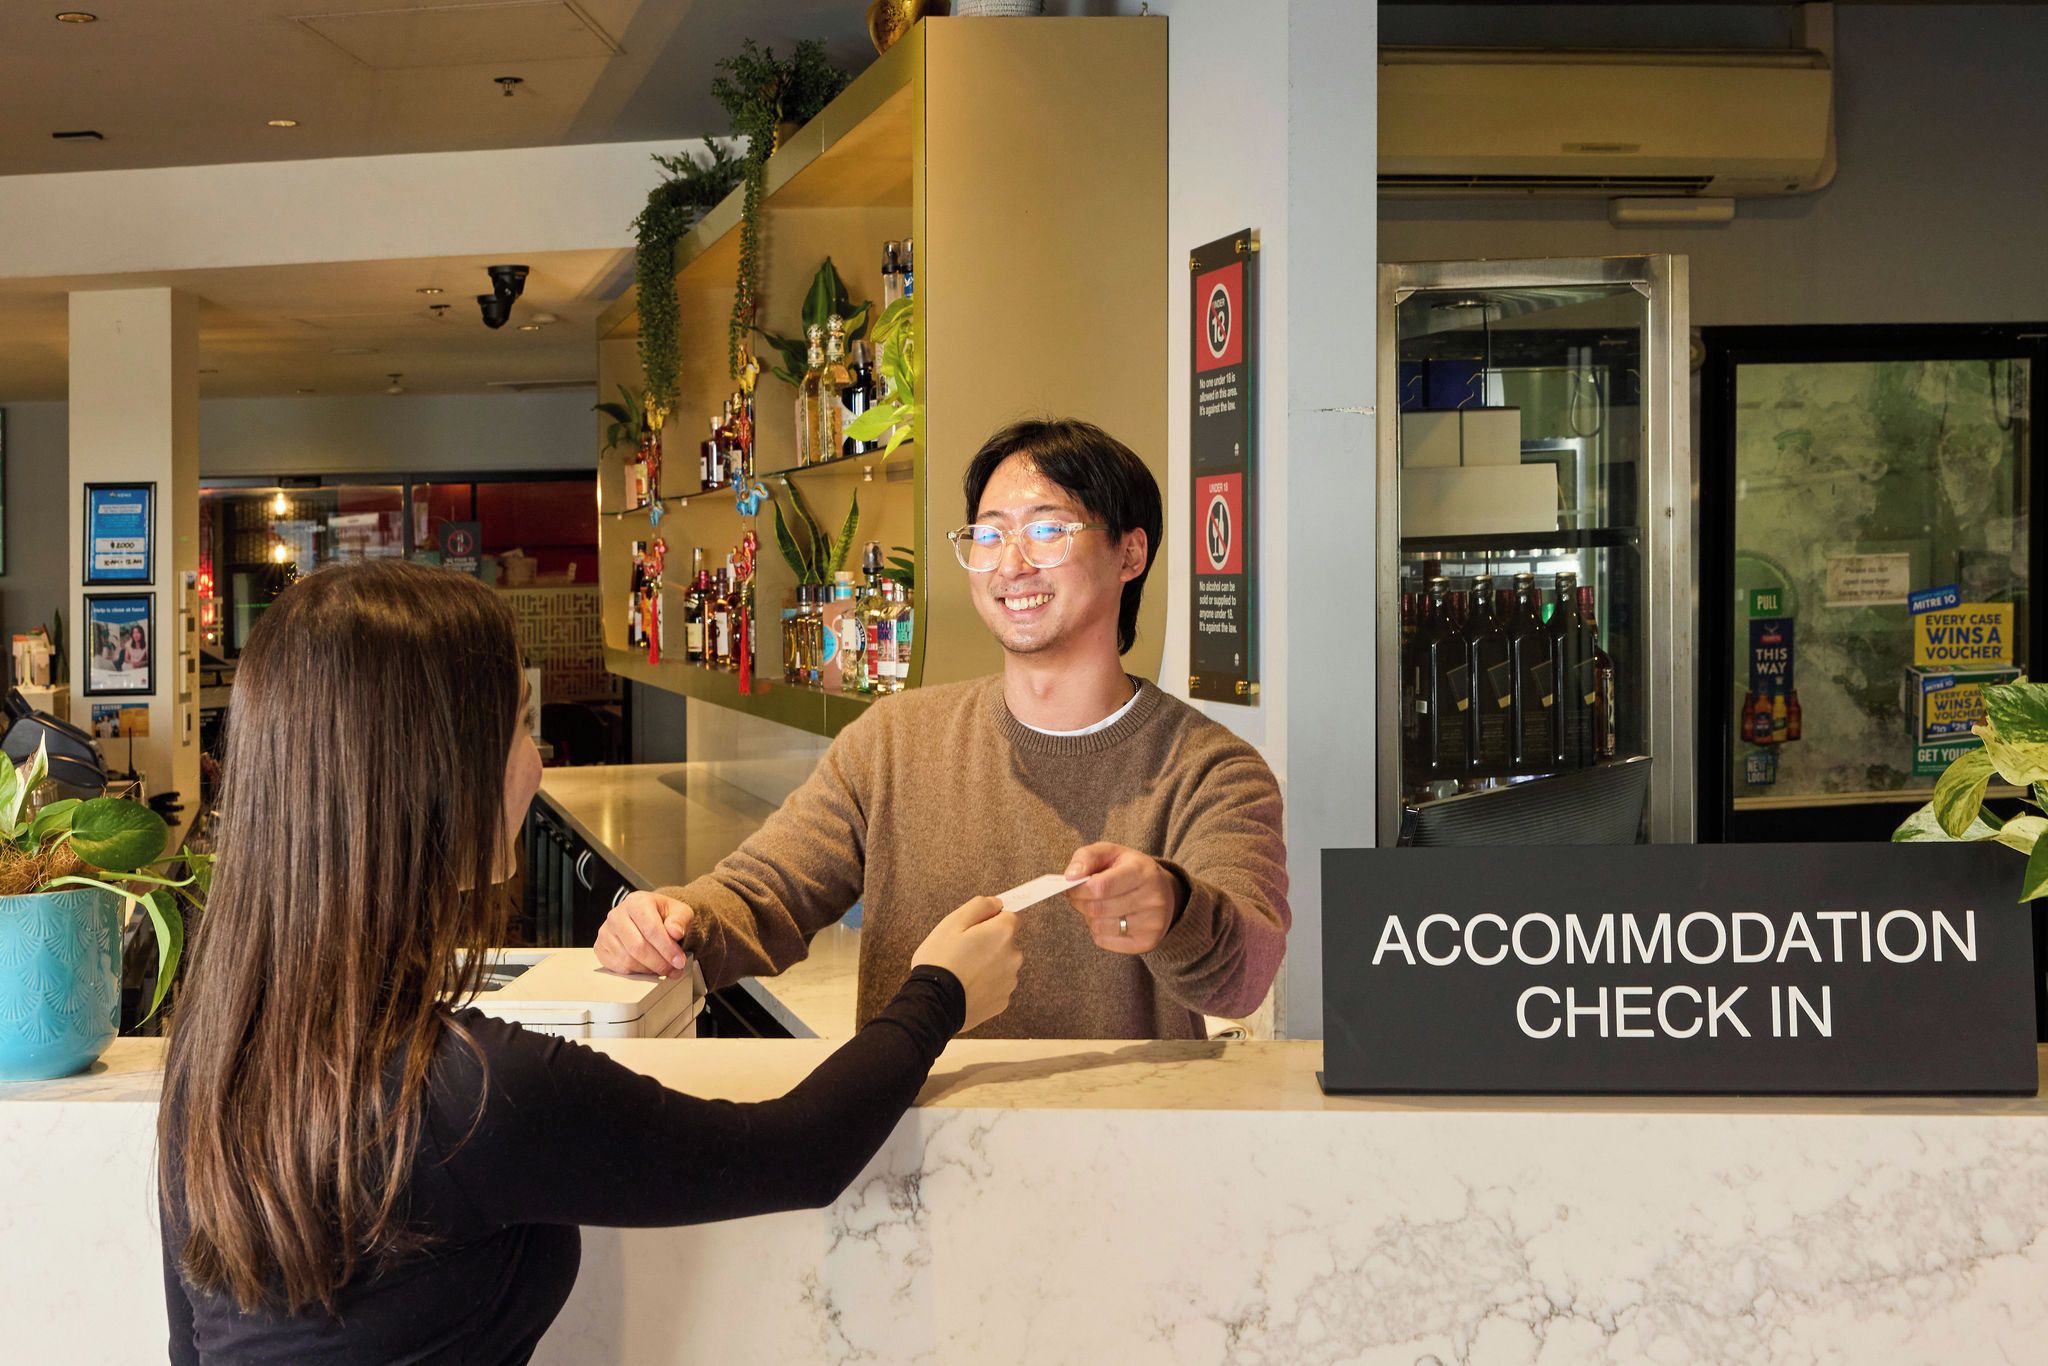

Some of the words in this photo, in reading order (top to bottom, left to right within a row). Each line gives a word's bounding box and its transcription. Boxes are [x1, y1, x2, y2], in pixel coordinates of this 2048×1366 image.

[1212, 311, 1226, 343] 18
[1200, 378, 1205, 389] No
[1214, 374, 1226, 386] under
[1200, 390, 1214, 402] allowed
[1215, 389, 1219, 399] in
[1206, 404, 1220, 416] against
[1209, 483, 1223, 493] UNDER
[1200, 581, 1205, 591] No
[1206, 581, 1220, 591] alcohol
[1230, 581, 1235, 592] be
[1200, 595, 1208, 605] sold
[1209, 596, 1213, 605] or
[1214, 595, 1231, 607] supplied
[1232, 595, 1236, 606] to
[1757, 595, 1777, 610] PULL
[1912, 598, 1942, 611] MITRE
[1944, 594, 1956, 604] 10
[1200, 610, 1214, 620] anyone
[1214, 609, 1226, 619] under
[1926, 614, 1966, 625] EVERY
[1970, 614, 2002, 624] CASE
[1206, 622, 1220, 634] against
[1926, 627, 1983, 644] WINS
[1987, 627, 2001, 644] A
[1756, 648, 1788, 660] THIS
[1926, 646, 2002, 659] VOUCHER
[1756, 662, 1787, 675] WAY
[1934, 691, 1960, 700] EVERY
[1935, 699, 1972, 710] WINS
[1975, 698, 1983, 707] A
[1918, 749, 1939, 762] GET
[1372, 910, 1976, 966] ACCOMMODATION
[1517, 986, 1751, 1038] CHECK
[1772, 986, 1831, 1037] IN
